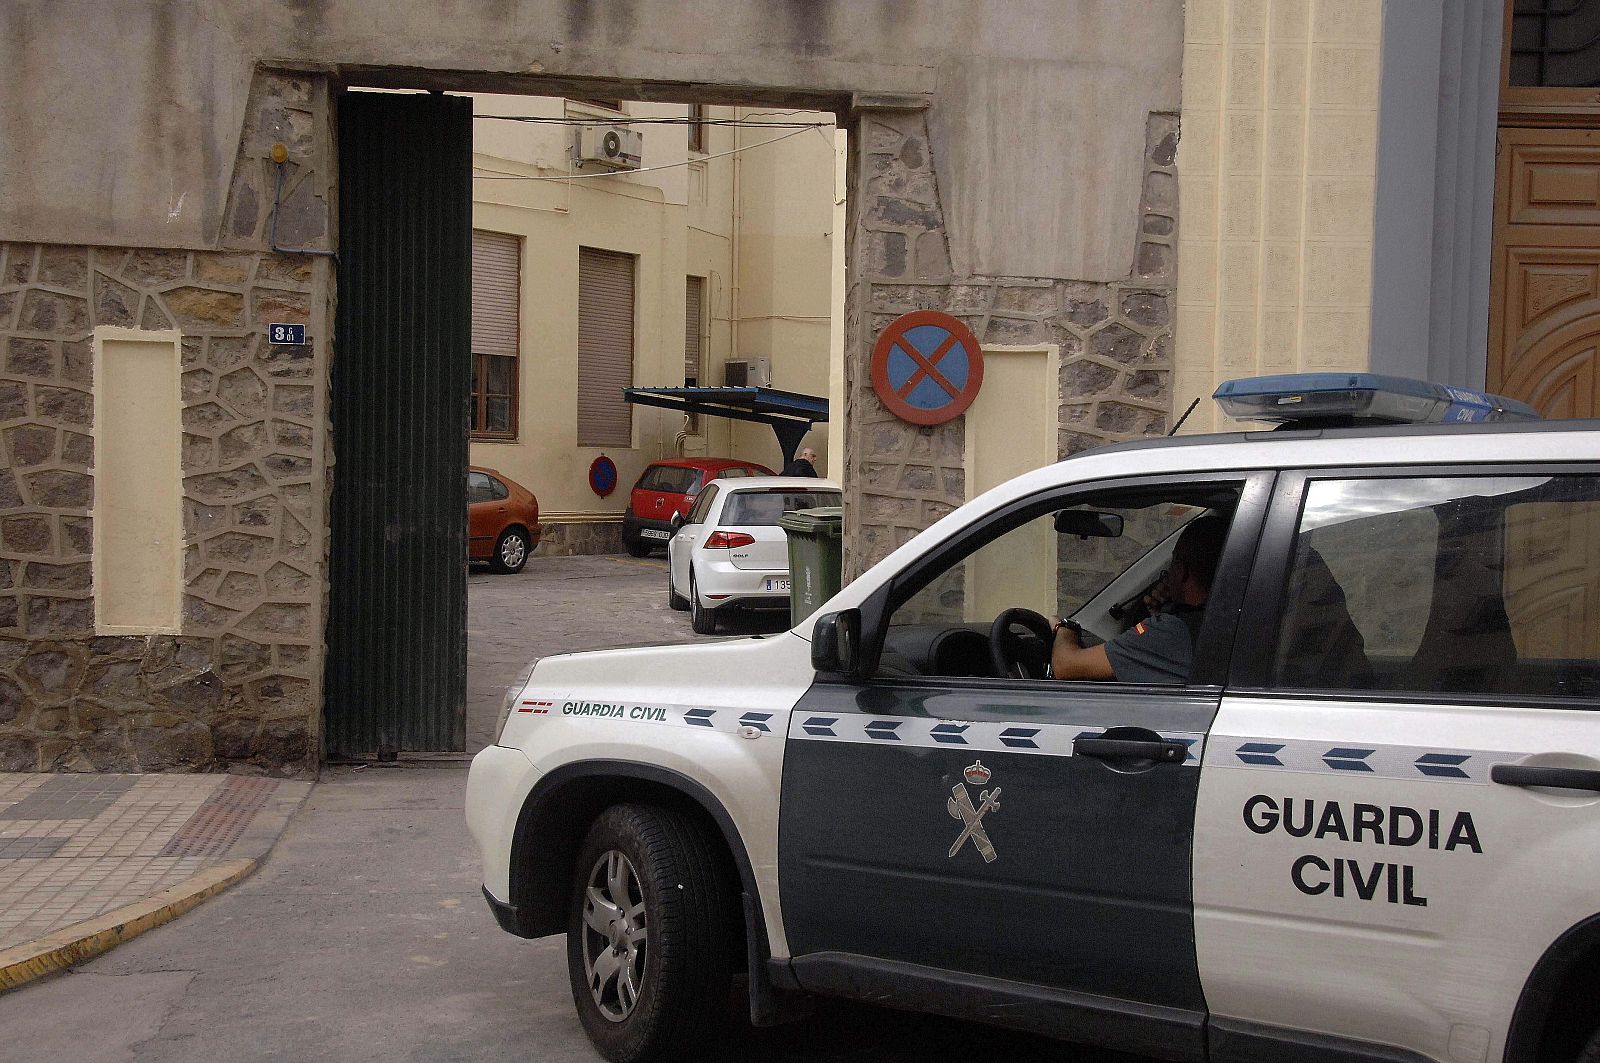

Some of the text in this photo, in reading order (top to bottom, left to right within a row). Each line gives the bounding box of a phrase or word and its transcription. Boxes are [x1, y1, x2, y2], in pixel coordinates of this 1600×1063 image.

[274, 326, 285, 341] 3
[1456, 408, 1476, 422] CIVIL
[562, 701, 668, 722] GUARDIA CIVIL
[1242, 794, 1483, 854] GUARDIA
[1291, 854, 1428, 907] CIVIL
